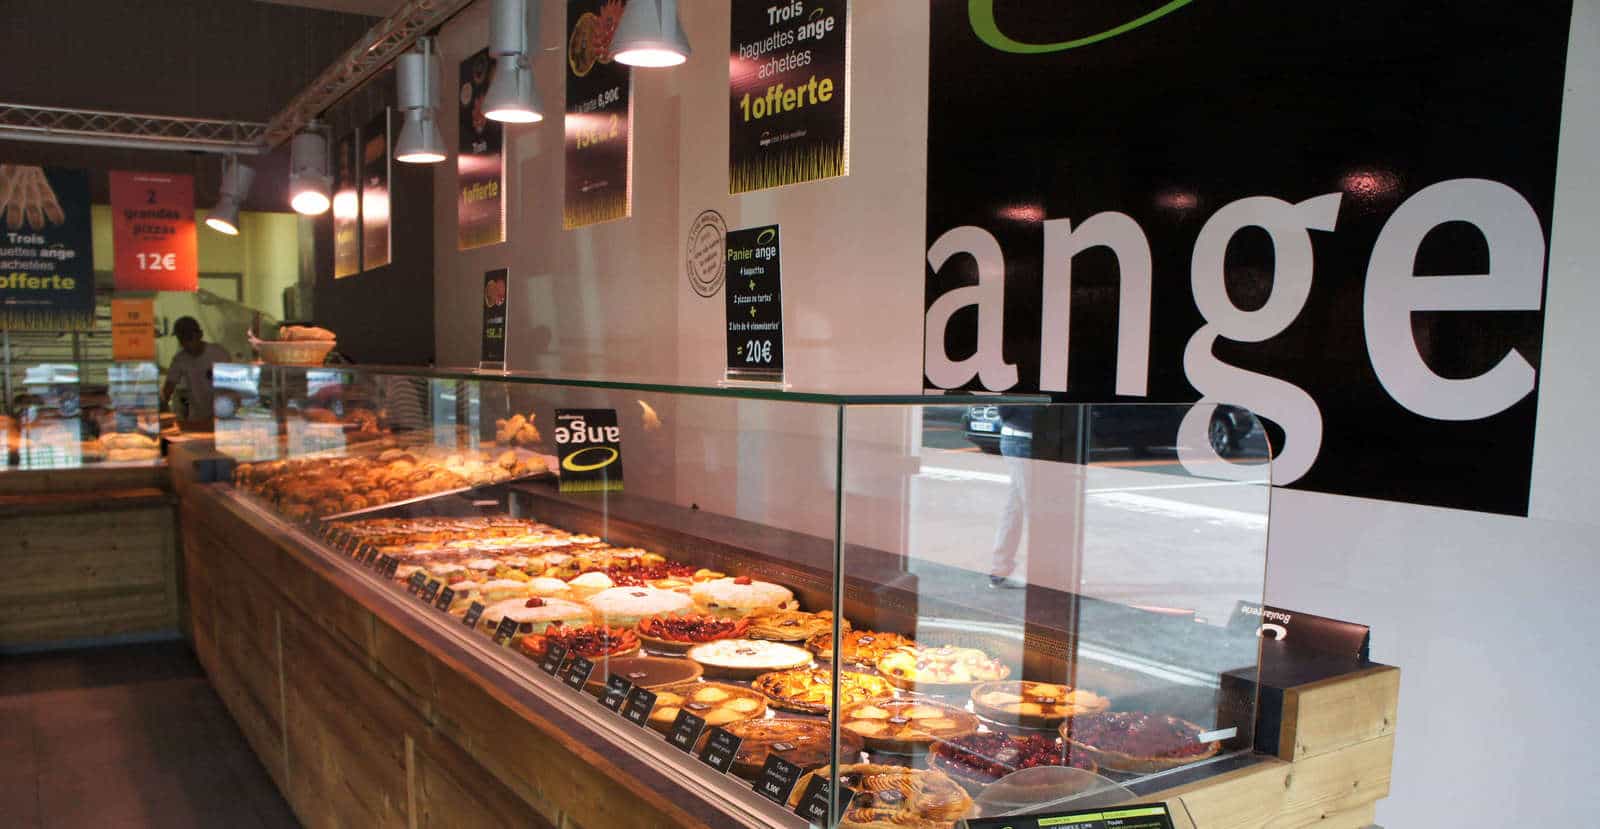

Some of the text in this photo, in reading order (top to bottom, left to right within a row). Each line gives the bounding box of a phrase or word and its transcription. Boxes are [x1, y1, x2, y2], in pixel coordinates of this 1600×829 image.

[767, 0, 803, 26] Trois
[739, 15, 835, 61] baguettes ange
[758, 49, 812, 80] achetées
[8, 232, 44, 244] Trois
[40, 249, 75, 260] ange
[136, 252, 177, 271] 12€
[728, 246, 777, 262] Panier ange
[925, 177, 1545, 487] ange
[746, 340, 772, 364] 20€
[555, 420, 620, 445] ange
